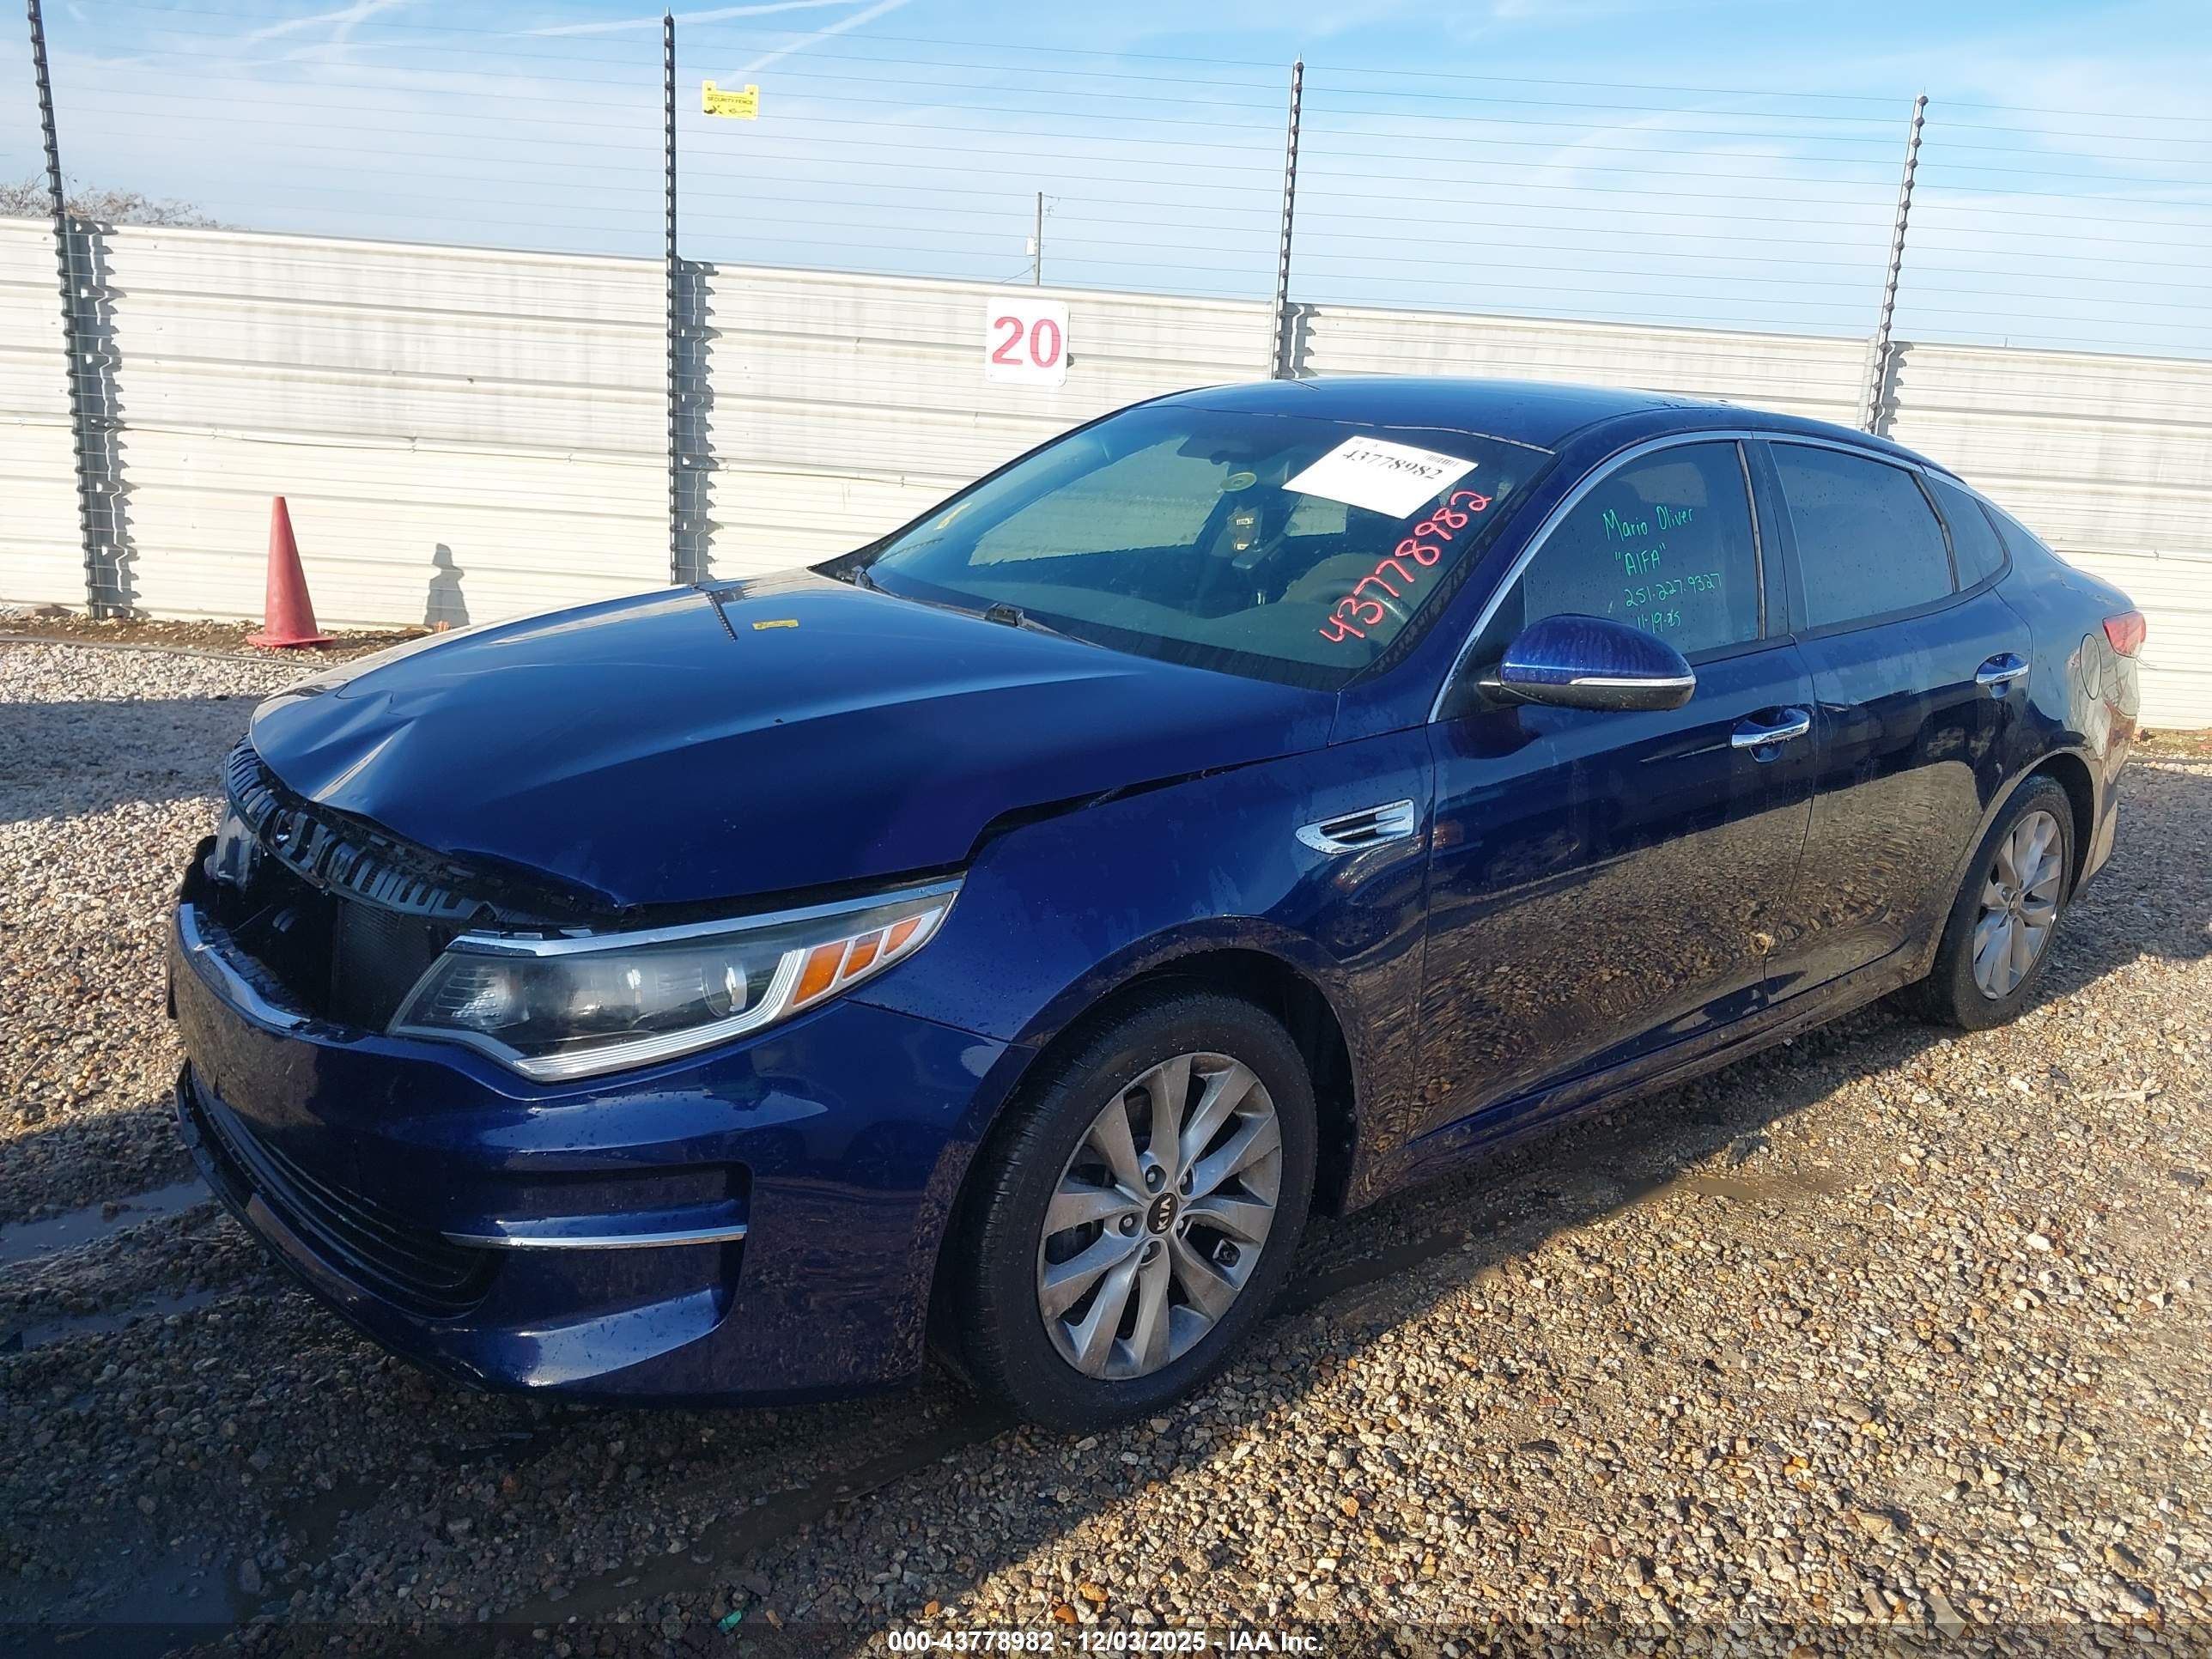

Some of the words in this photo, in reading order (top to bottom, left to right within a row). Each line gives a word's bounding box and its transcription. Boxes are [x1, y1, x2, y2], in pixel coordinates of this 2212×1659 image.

[992, 316, 1061, 368] 20
[1342, 449, 1443, 480] 43778982
[1601, 508, 1649, 542] Mario
[1656, 505, 1693, 530] Oliver
[1319, 490, 1492, 643] 43778982
[1156, 1197, 1171, 1231] KIA
